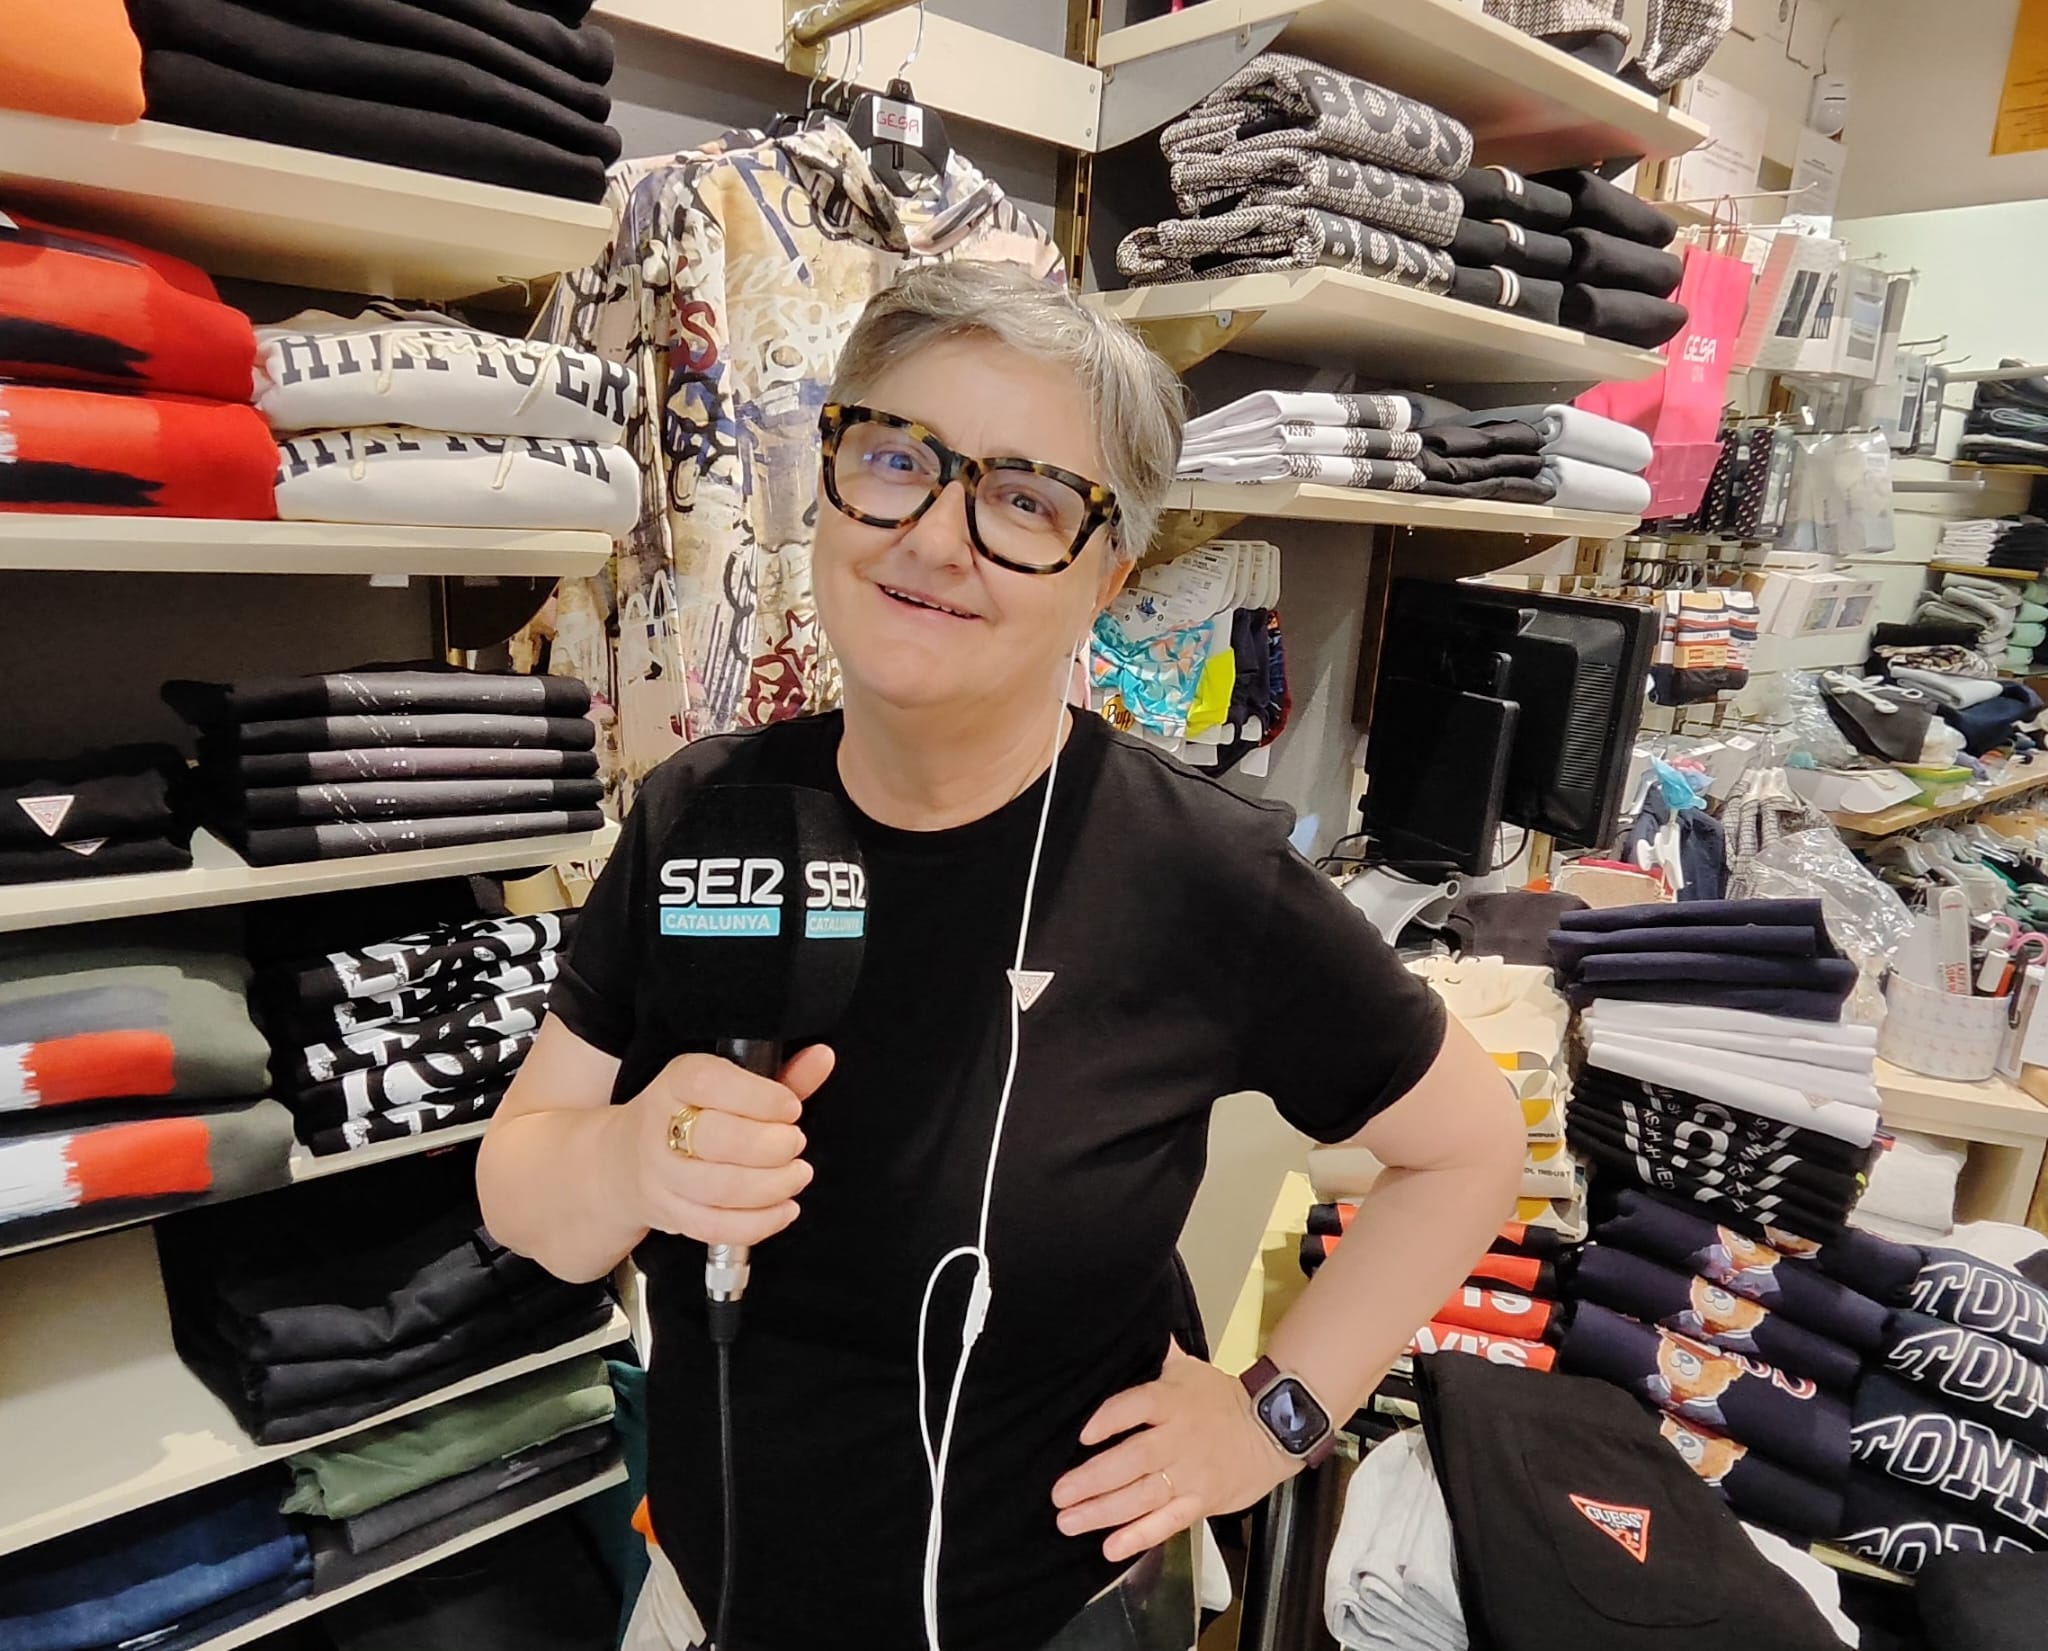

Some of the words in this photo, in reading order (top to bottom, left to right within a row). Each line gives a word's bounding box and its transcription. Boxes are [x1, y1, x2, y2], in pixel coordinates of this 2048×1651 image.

[876, 110, 919, 134] GESA
[658, 858, 785, 905] SER
[804, 860, 867, 909] SER
[664, 913, 771, 931] CATALUNYA
[1585, 1505, 1644, 1529] GUESS
